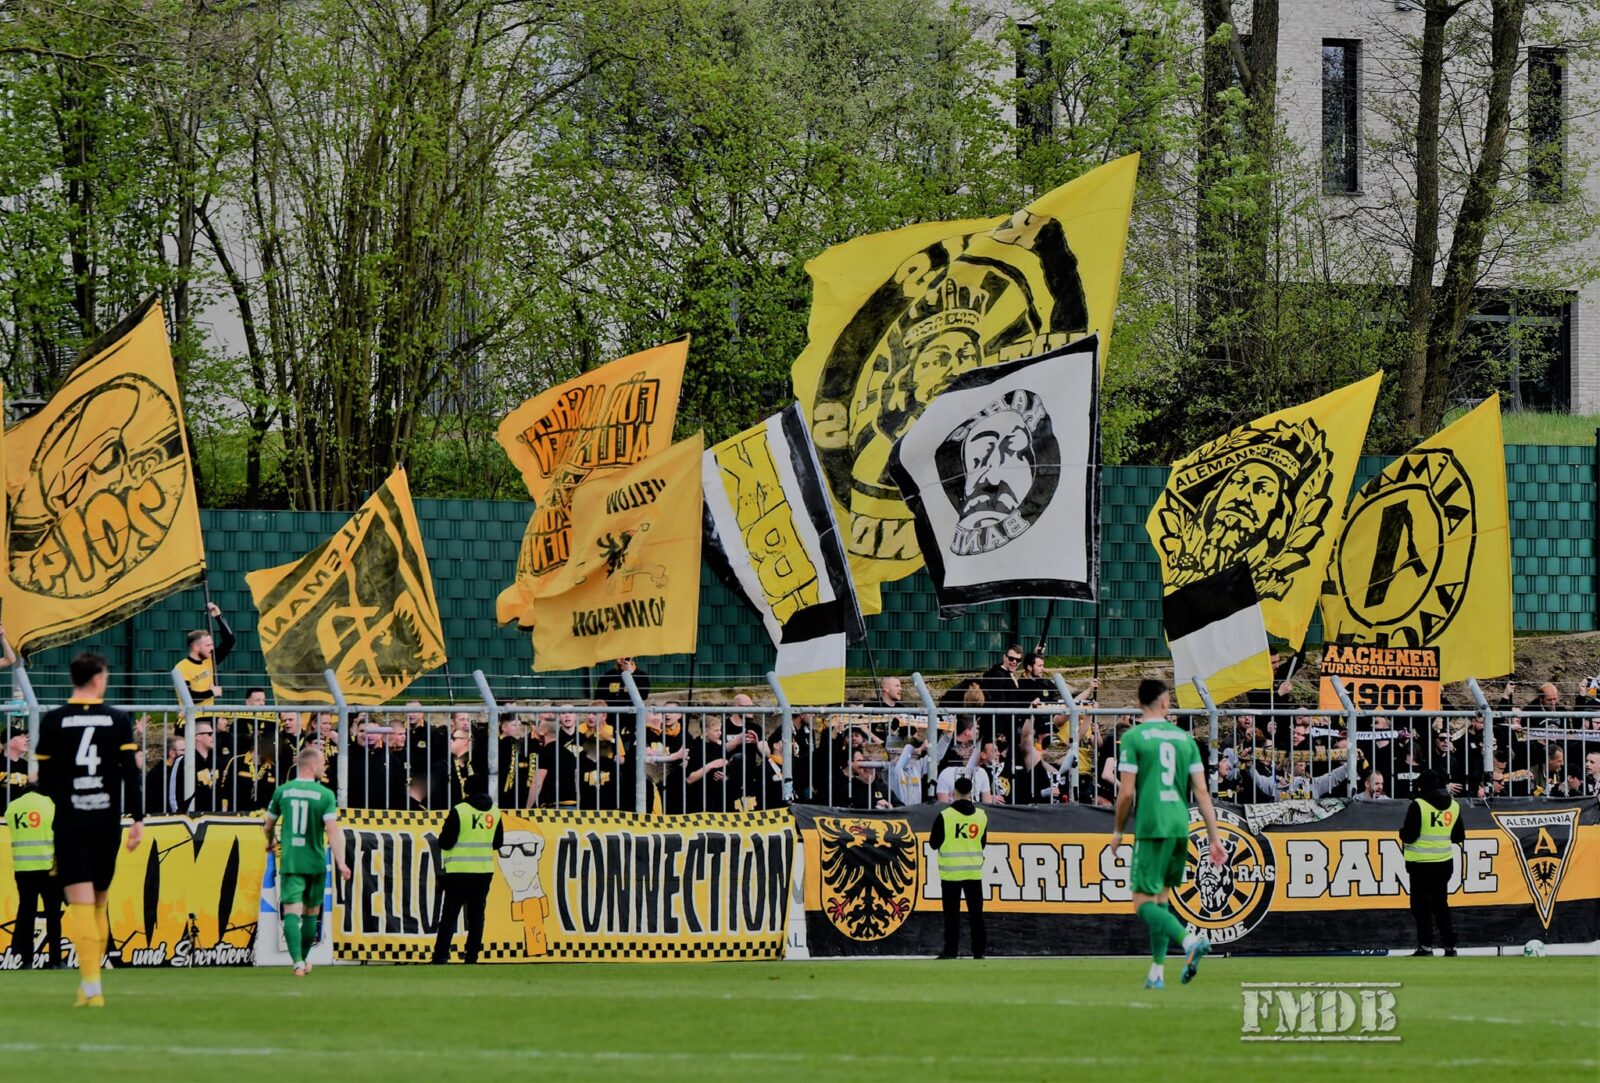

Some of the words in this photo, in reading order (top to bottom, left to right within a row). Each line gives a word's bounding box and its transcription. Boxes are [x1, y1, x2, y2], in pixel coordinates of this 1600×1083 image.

[1323, 645, 1438, 667] AACHENER
[75, 726, 102, 776] 4
[1159, 741, 1177, 787] 9
[13, 811, 42, 830] K9
[290, 799, 309, 835] 11
[470, 812, 495, 830] K9
[1429, 811, 1453, 828] K9
[1506, 814, 1573, 826] ALEMANNIA
[954, 822, 980, 840] K9
[1534, 827, 1558, 855] A
[334, 828, 469, 935] YELLO
[556, 828, 794, 934] CONNECTION
[1237, 865, 1277, 883] RAS
[132, 942, 166, 966] und
